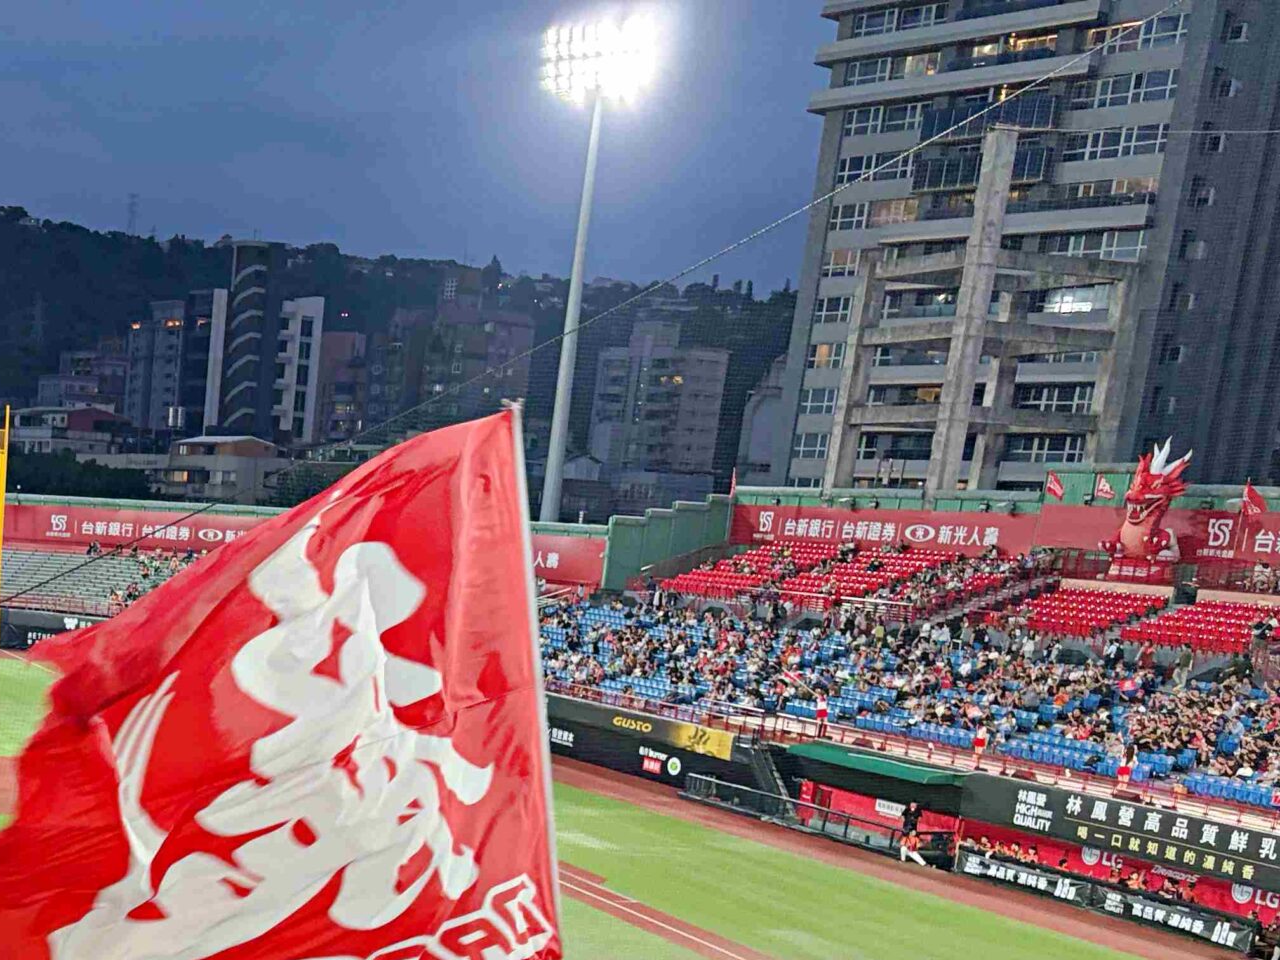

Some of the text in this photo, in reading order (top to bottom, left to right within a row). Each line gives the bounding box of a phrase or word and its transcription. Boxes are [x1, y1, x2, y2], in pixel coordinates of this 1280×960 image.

[81, 520, 134, 537] 台新銀行
[784, 518, 834, 538] 台新銀行
[937, 525, 999, 546] 新光人壽
[612, 716, 652, 733] GUSTO
[1015, 802, 1038, 817] HIGH
[1013, 813, 1052, 832] QUALITY
[1065, 794, 1278, 860] 林鳳營高品質鮮乳
[1077, 825, 1255, 880] 喝一口就知道的濃純香
[1254, 888, 1280, 909] LG
